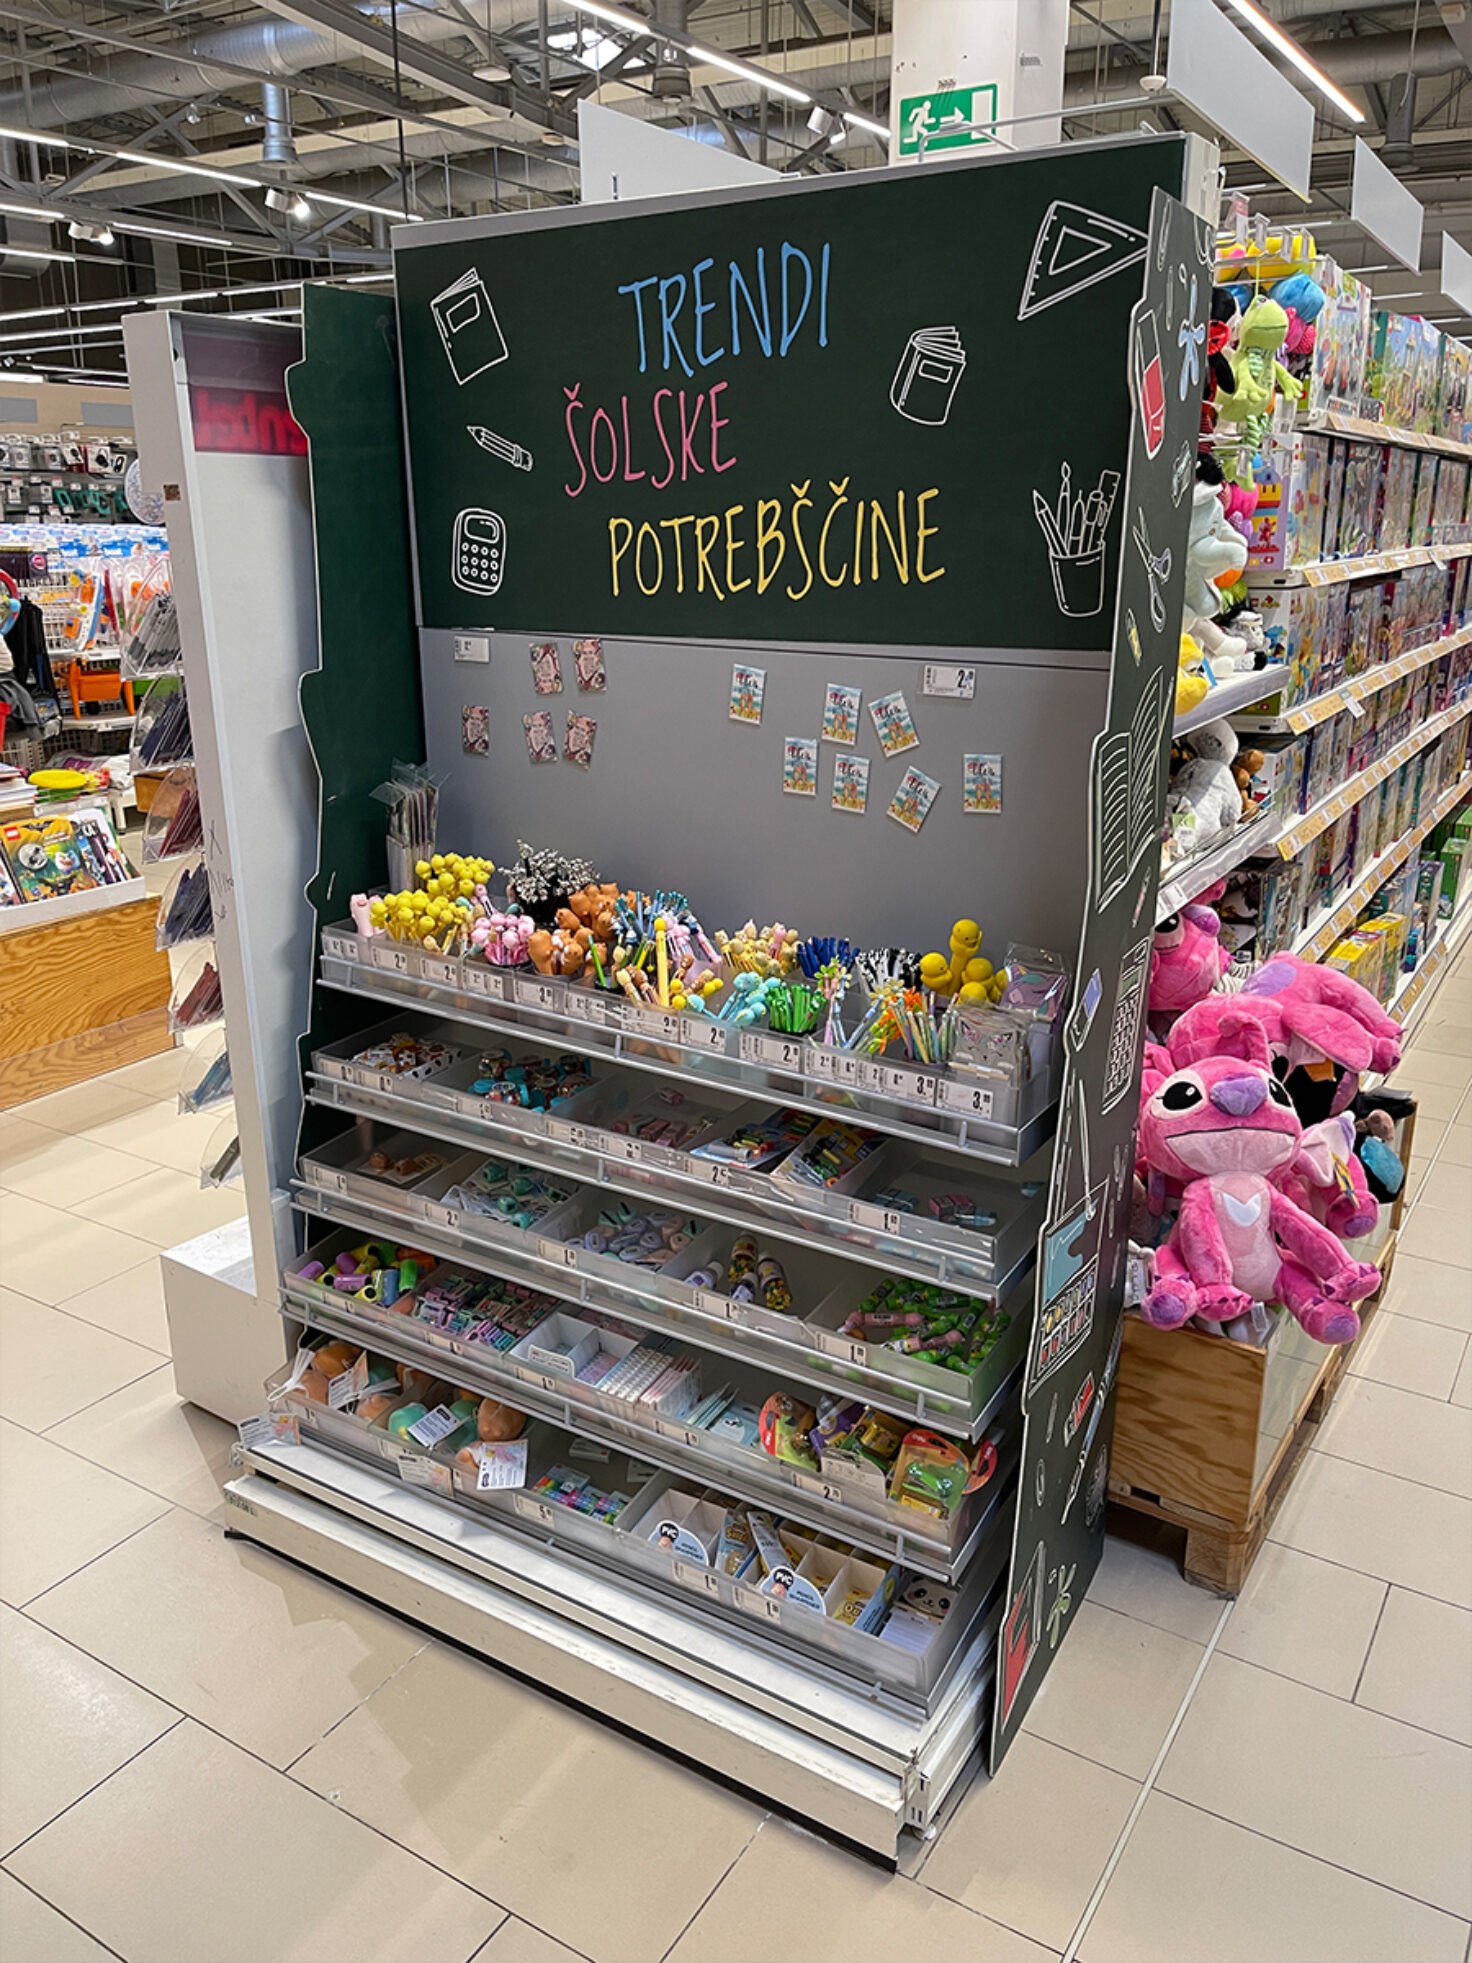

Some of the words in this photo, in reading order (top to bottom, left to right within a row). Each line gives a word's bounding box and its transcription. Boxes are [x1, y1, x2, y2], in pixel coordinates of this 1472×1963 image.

[617, 241, 830, 378] TRENDI
[562, 381, 738, 497] ŠOLSKE
[608, 476, 946, 601] POTREBŠČINE
